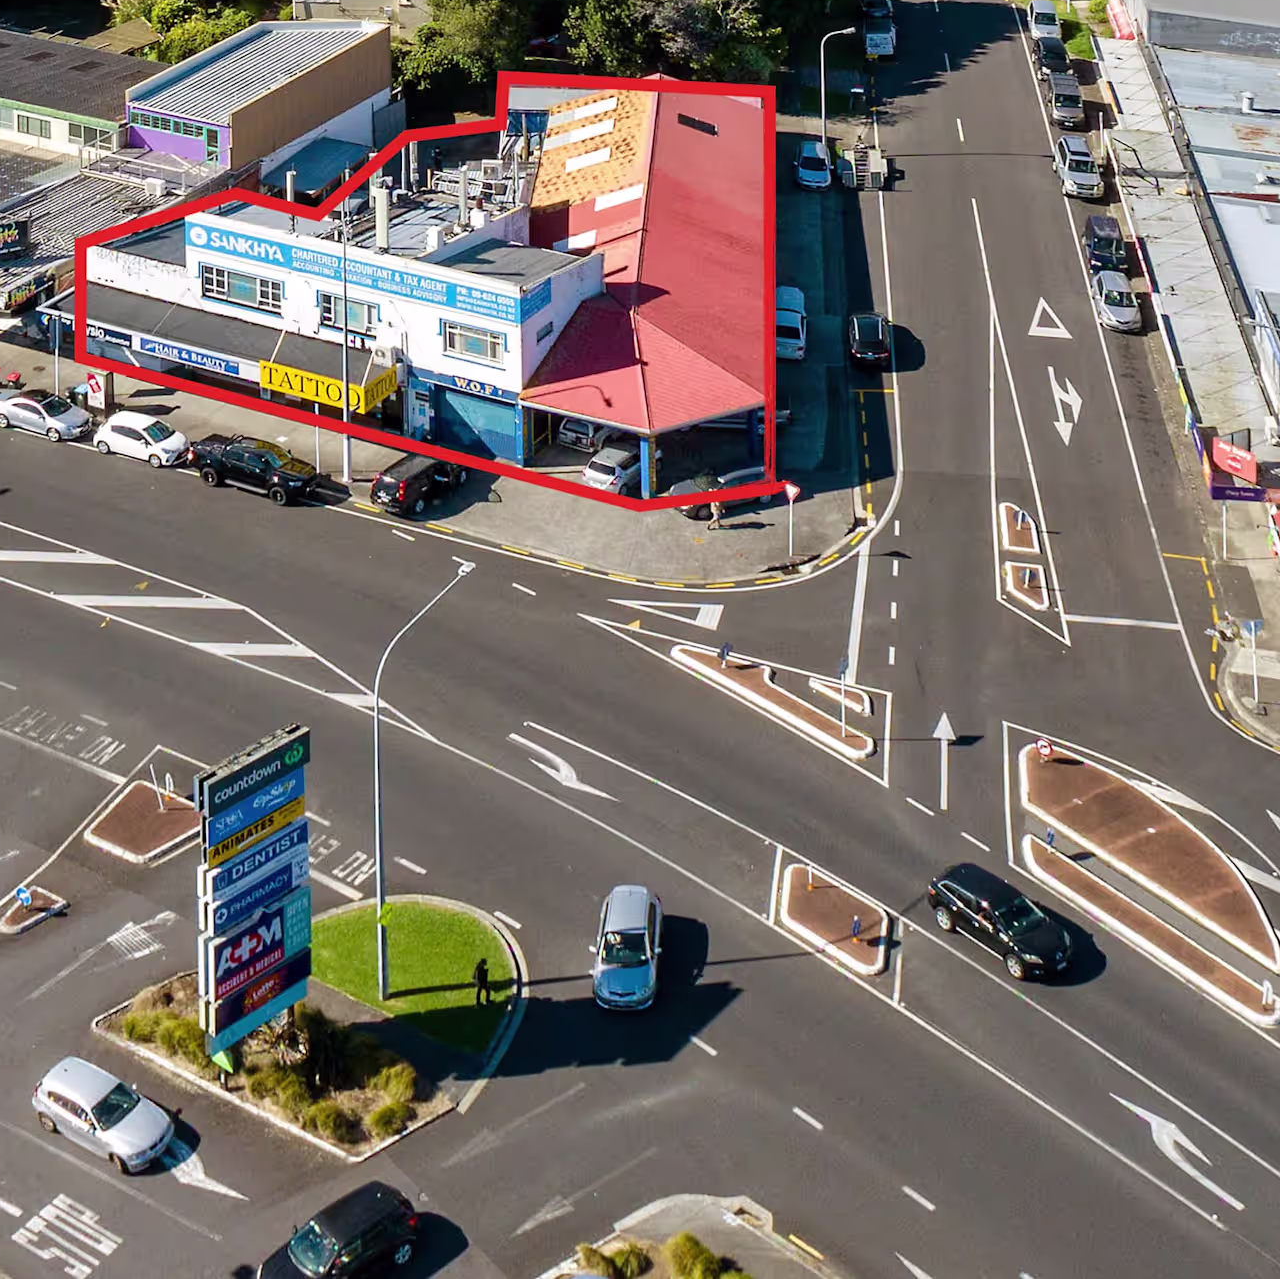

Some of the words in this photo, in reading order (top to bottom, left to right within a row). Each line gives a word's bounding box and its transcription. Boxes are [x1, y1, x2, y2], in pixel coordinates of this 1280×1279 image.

[210, 232, 284, 262] SANKHYA
[292, 261, 335, 276] ACCOUNTING
[291, 248, 338, 267] CHARTERED
[340, 260, 392, 279] ACCOUNTANT
[394, 274, 401, 282] &
[403, 275, 418, 287] TAX
[420, 279, 448, 293] AGENT
[153, 343, 180, 361] HAIR
[181, 349, 189, 359] &
[191, 352, 226, 370] BEAUTY
[263, 366, 361, 407] TATTOO
[214, 761, 281, 804] countdown
[213, 815, 275, 859] ANIMATES
[233, 829, 300, 879] DENTIST
[230, 872, 289, 915] PHARMACY
[218, 969, 248, 996] ACCIDENT
[256, 949, 282, 972] MEDICAL
[10, 1192, 124, 1279] STOP
